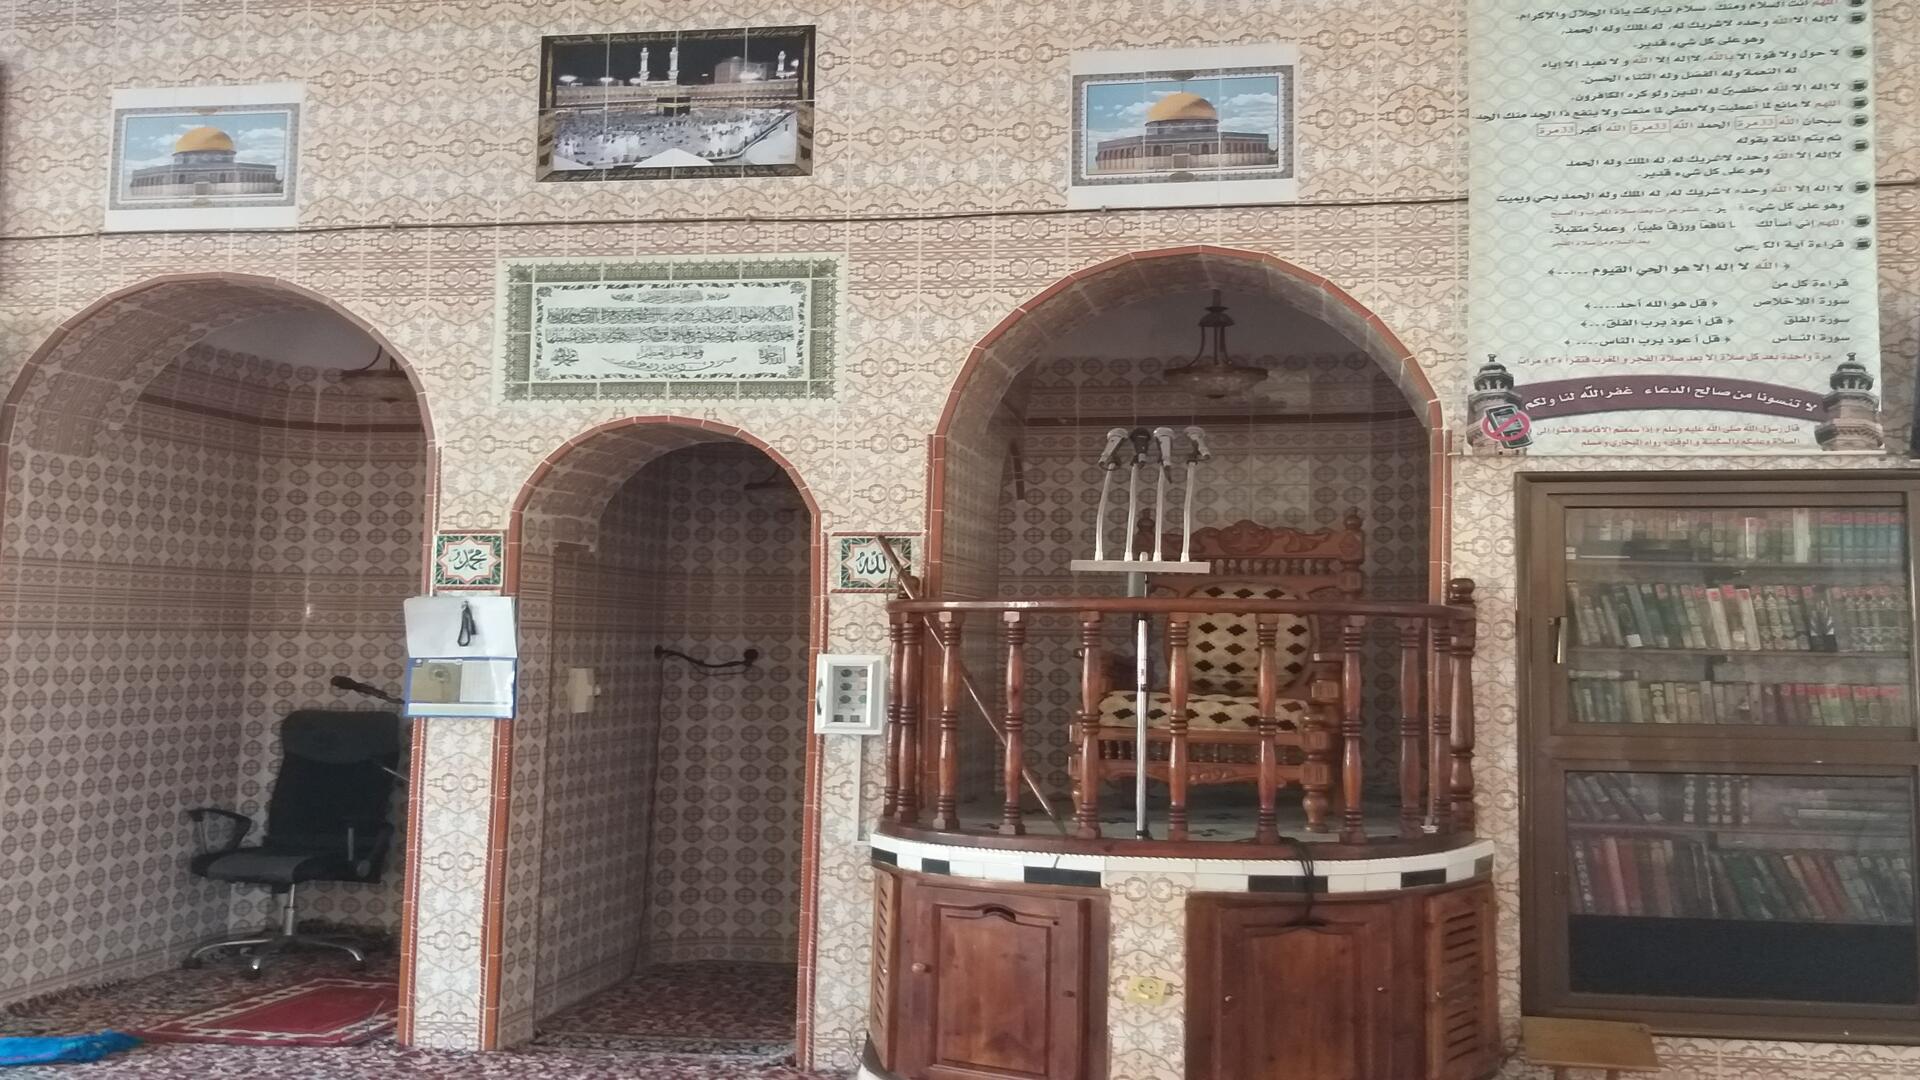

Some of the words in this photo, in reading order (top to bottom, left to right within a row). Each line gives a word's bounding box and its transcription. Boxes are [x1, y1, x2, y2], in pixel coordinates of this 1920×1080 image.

[1580, 384, 1604, 399] الله
[1604, 385, 1634, 399] غفر
[1644, 384, 1691, 395] الدعاء
[1693, 385, 1731, 399] صالح
[1732, 390, 1753, 401] من
[1757, 392, 1802, 409] تنسونا
[1804, 401, 1818, 412] لا
[855, 550, 887, 575] الله
